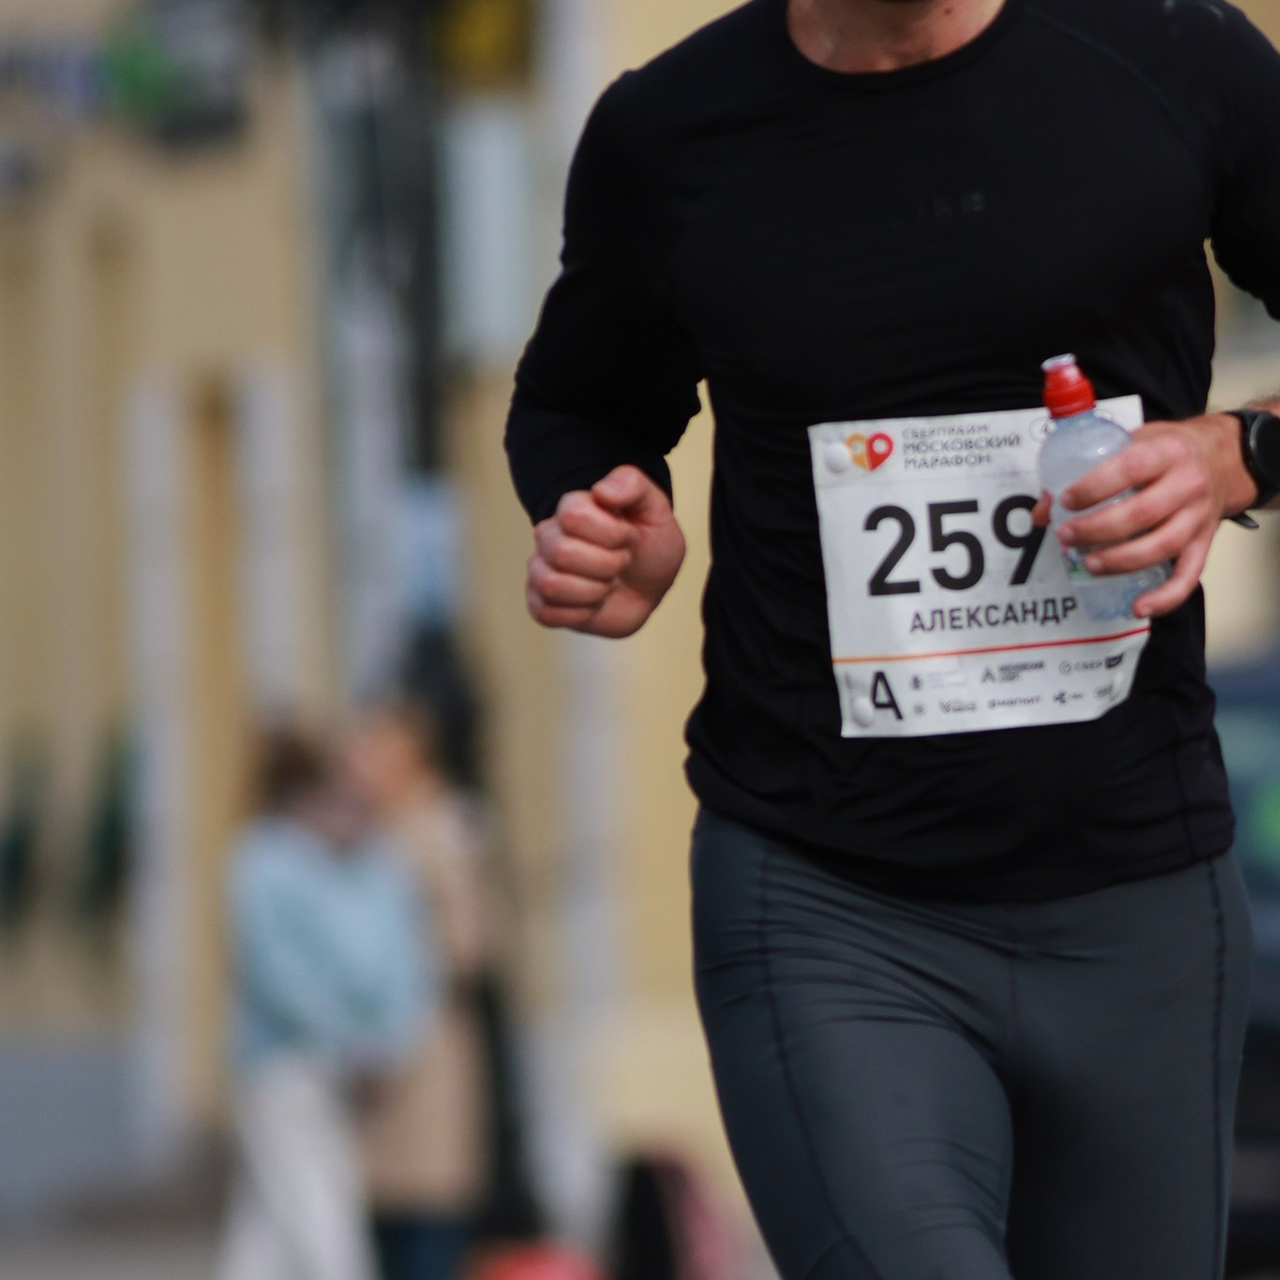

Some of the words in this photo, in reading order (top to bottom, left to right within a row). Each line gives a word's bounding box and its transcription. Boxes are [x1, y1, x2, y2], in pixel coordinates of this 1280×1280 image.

[902, 431, 1021, 453] МОСКОВСКИЙ
[903, 453, 992, 470] МАРАФОН
[910, 596, 1077, 632] АЛЕКСАНДР
